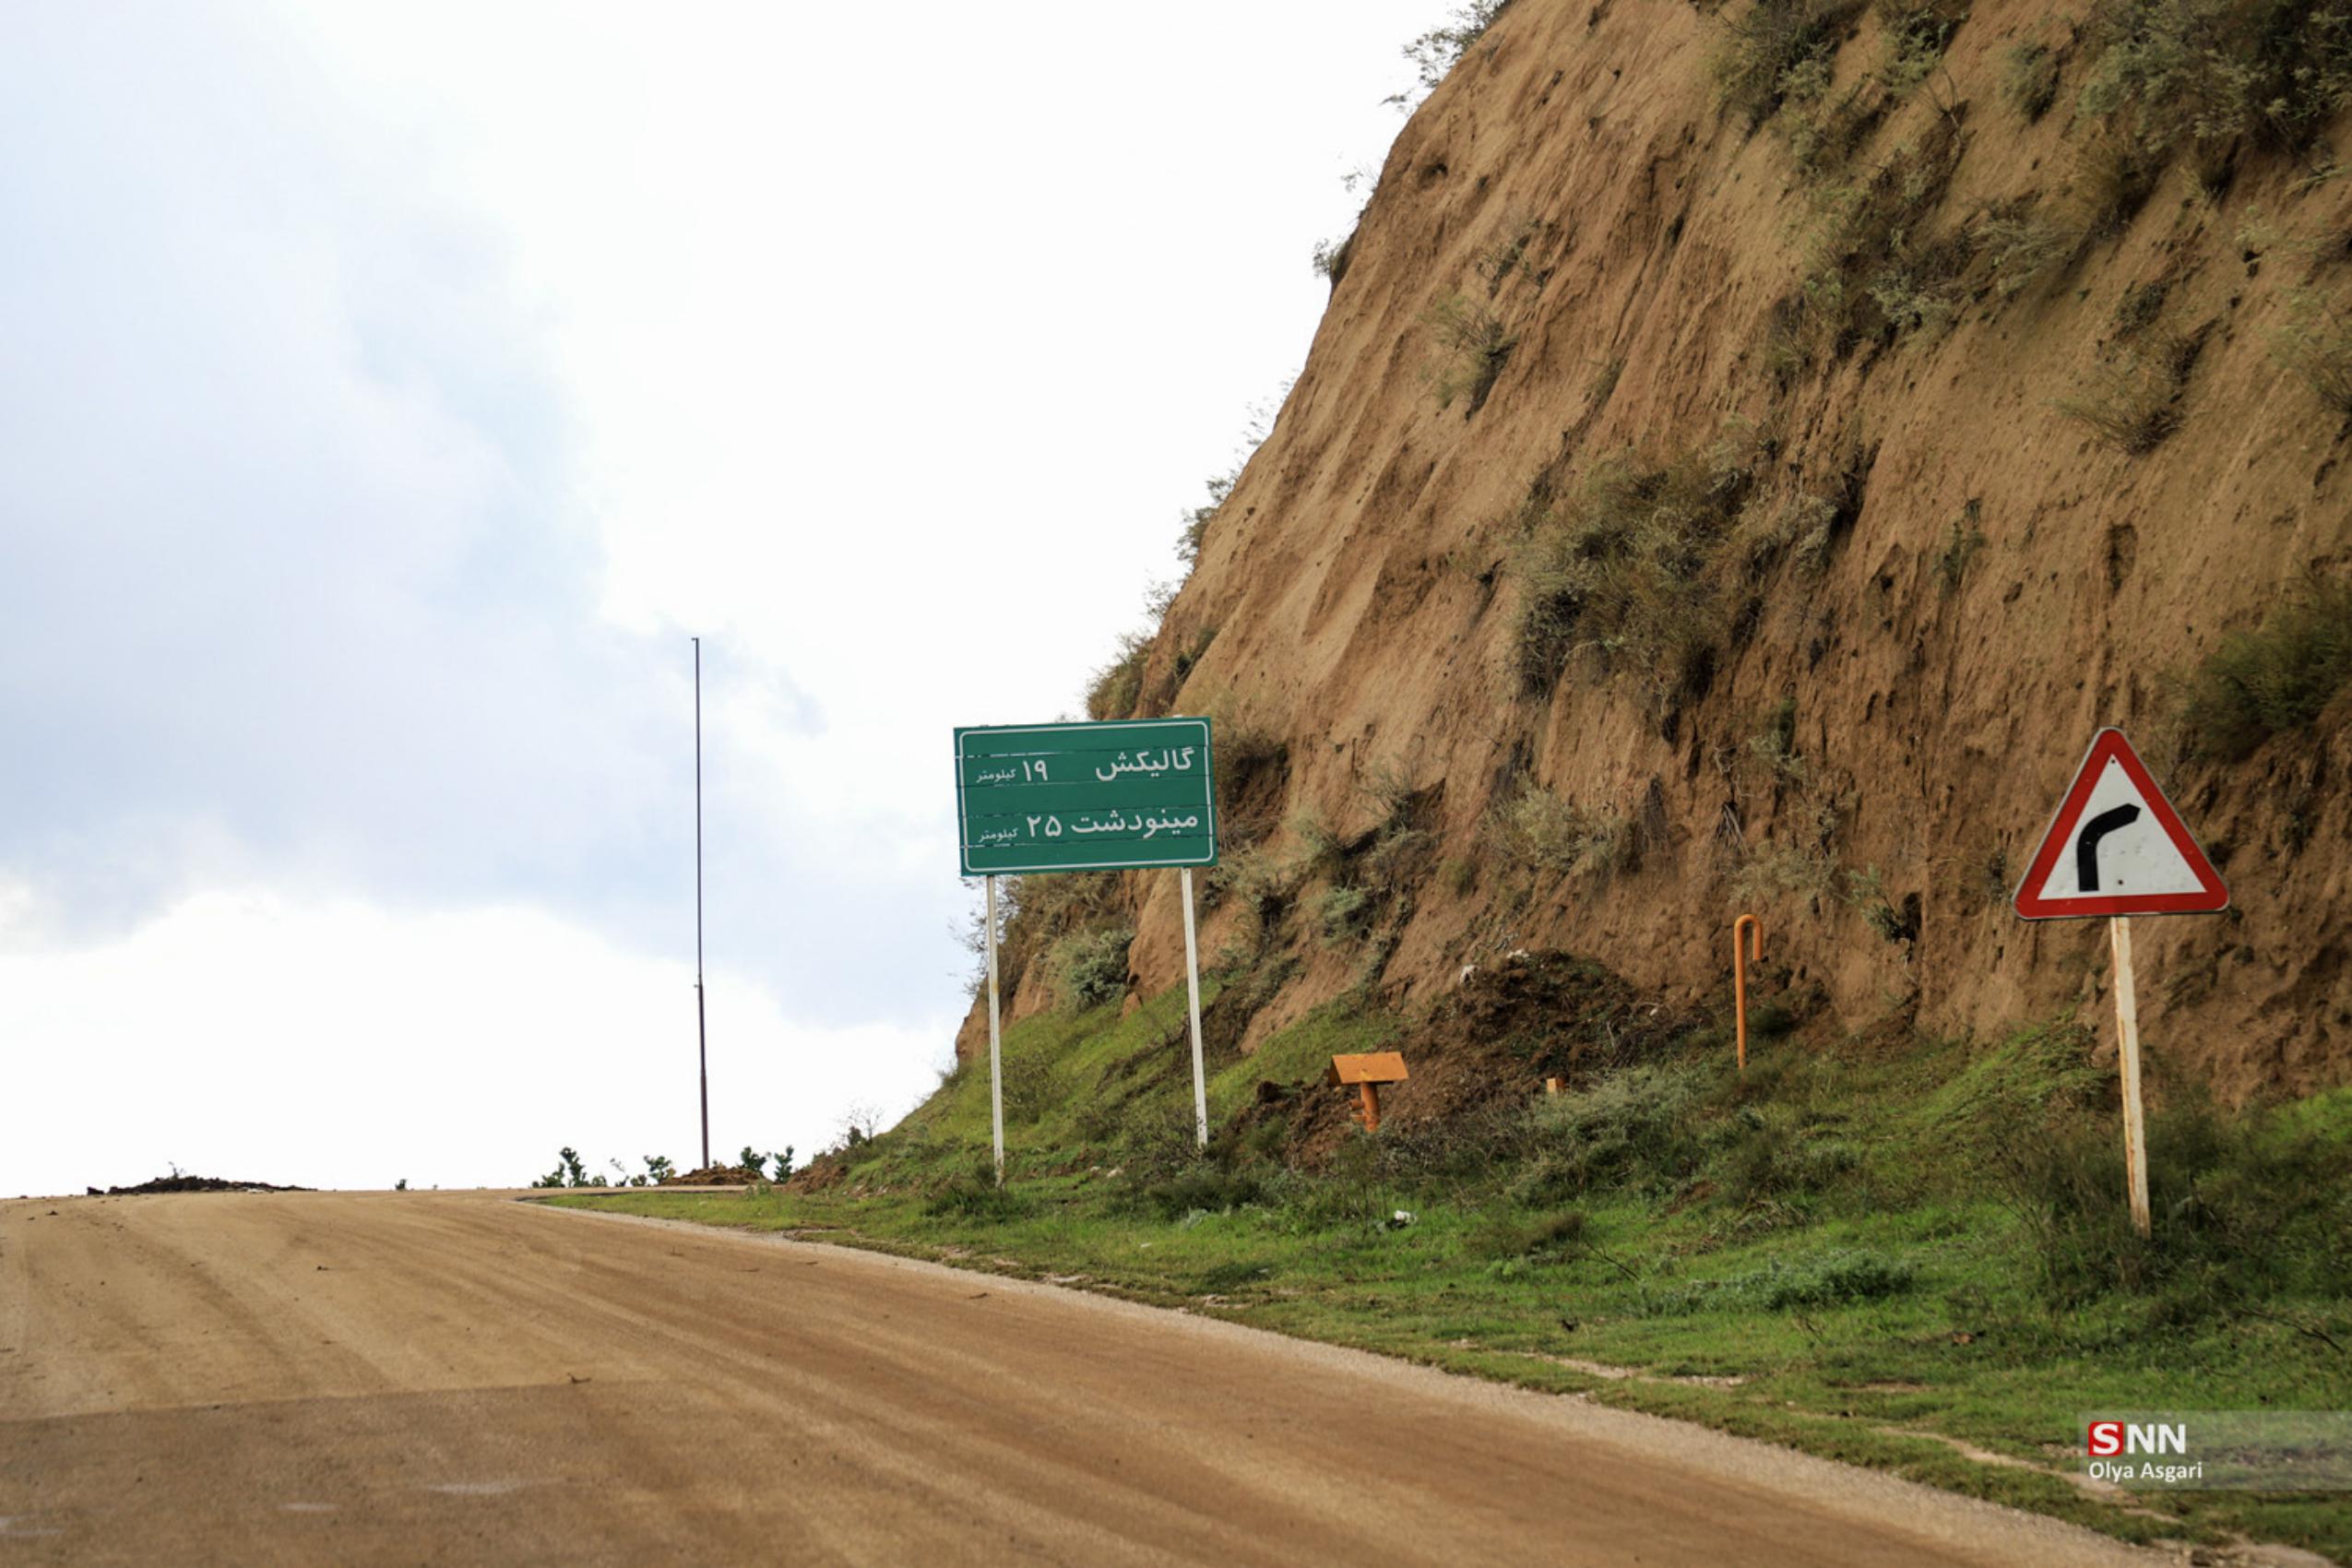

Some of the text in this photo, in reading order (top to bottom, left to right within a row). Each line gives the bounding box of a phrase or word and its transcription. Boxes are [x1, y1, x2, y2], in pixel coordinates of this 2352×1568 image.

[976, 747, 1195, 783] گالیکش ۱۹ کیلومتر
[978, 809, 1199, 843] مینودشت ۲۵ کیلومتر
